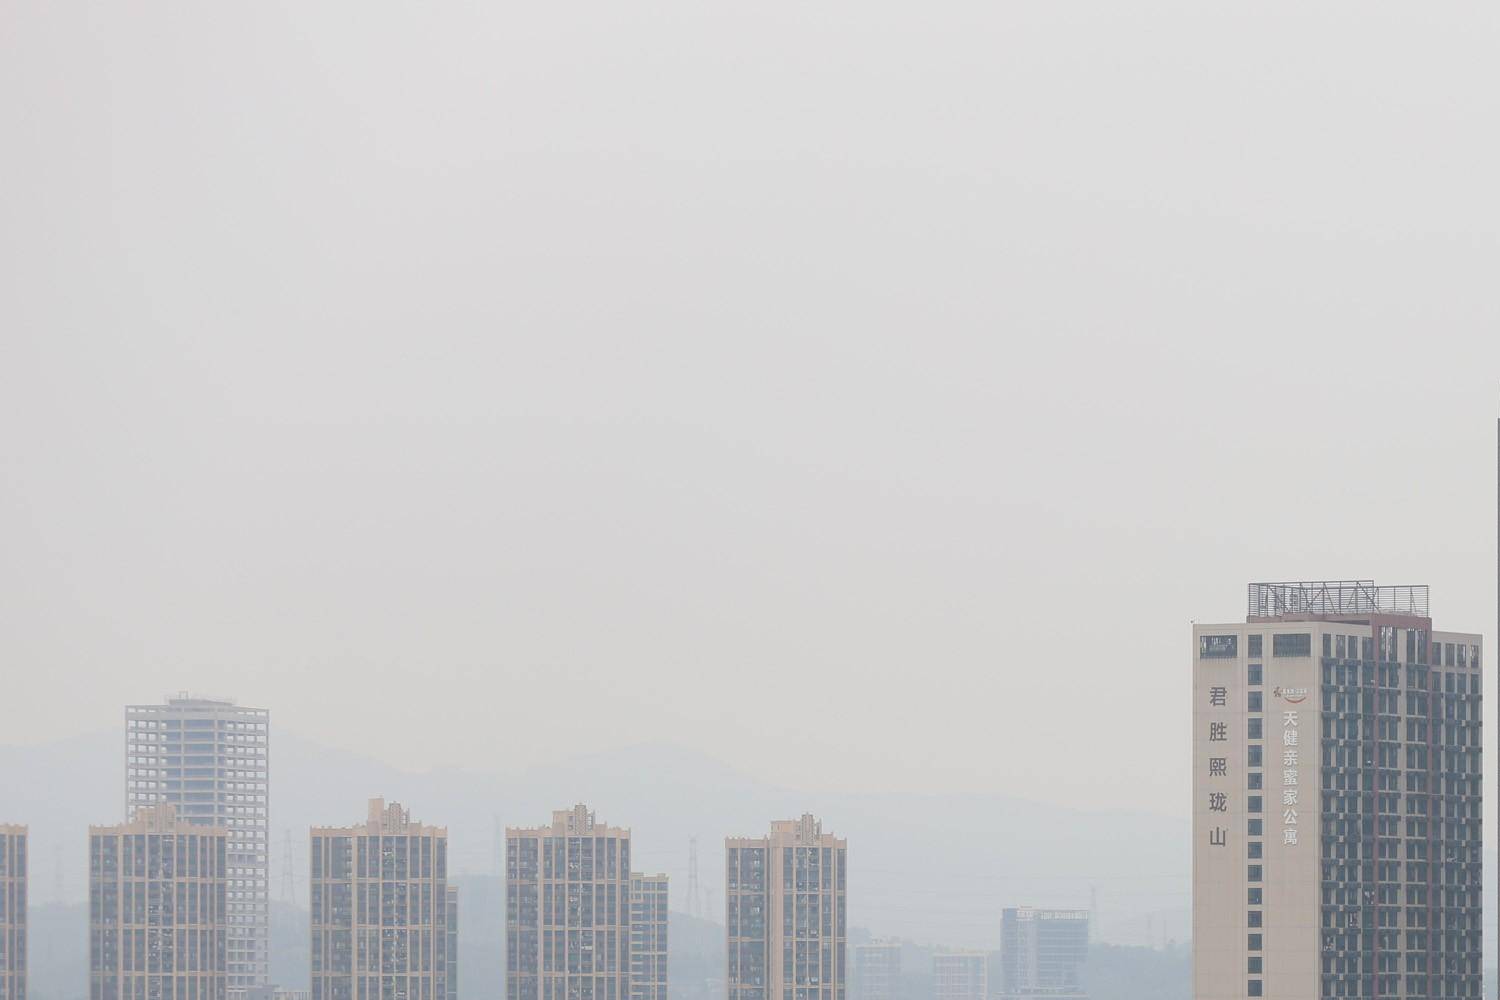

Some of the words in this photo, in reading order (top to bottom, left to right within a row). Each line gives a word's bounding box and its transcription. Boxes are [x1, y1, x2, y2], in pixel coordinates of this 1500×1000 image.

[1209, 687, 1227, 847] 君胜熙珑山
